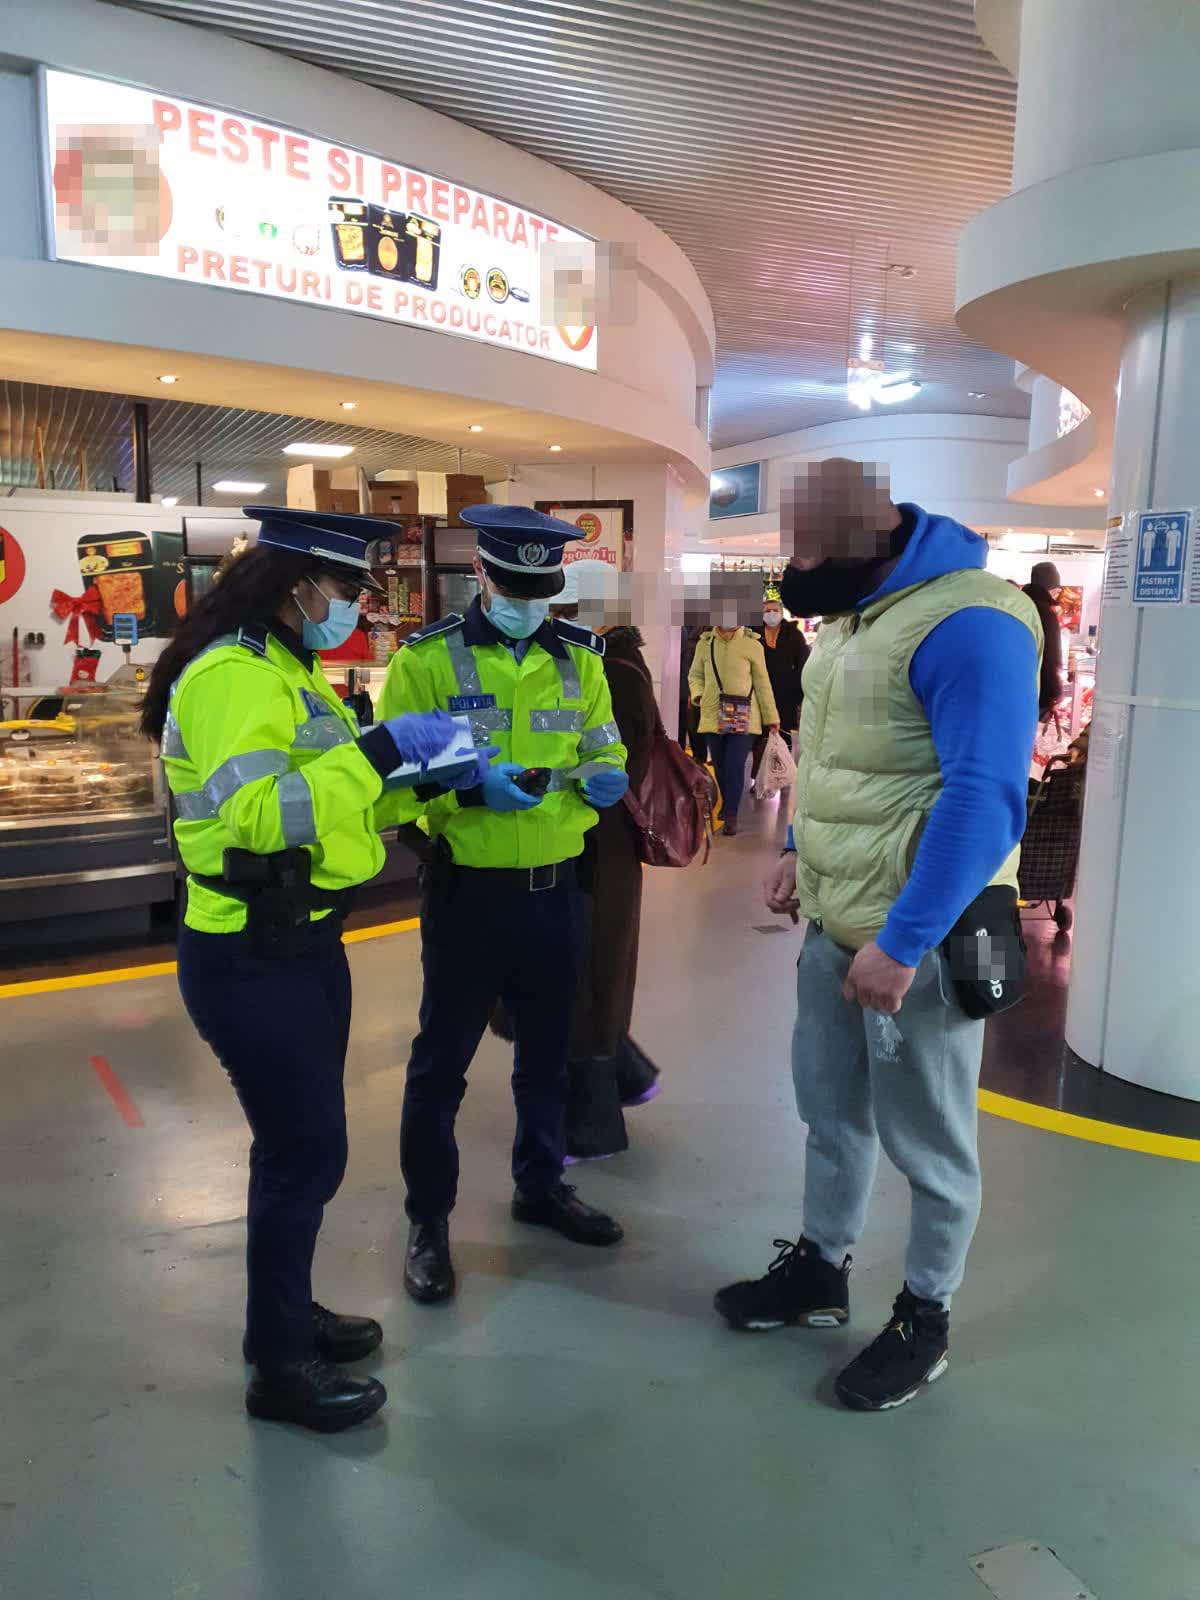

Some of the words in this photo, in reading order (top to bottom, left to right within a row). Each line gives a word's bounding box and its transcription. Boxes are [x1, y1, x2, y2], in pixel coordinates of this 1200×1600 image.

[151, 99, 311, 181] PESTE
[326, 147, 365, 196] SI
[176, 245, 332, 301] PRETURI
[344, 279, 384, 311] DE
[393, 290, 551, 352] PRODUCATOR
